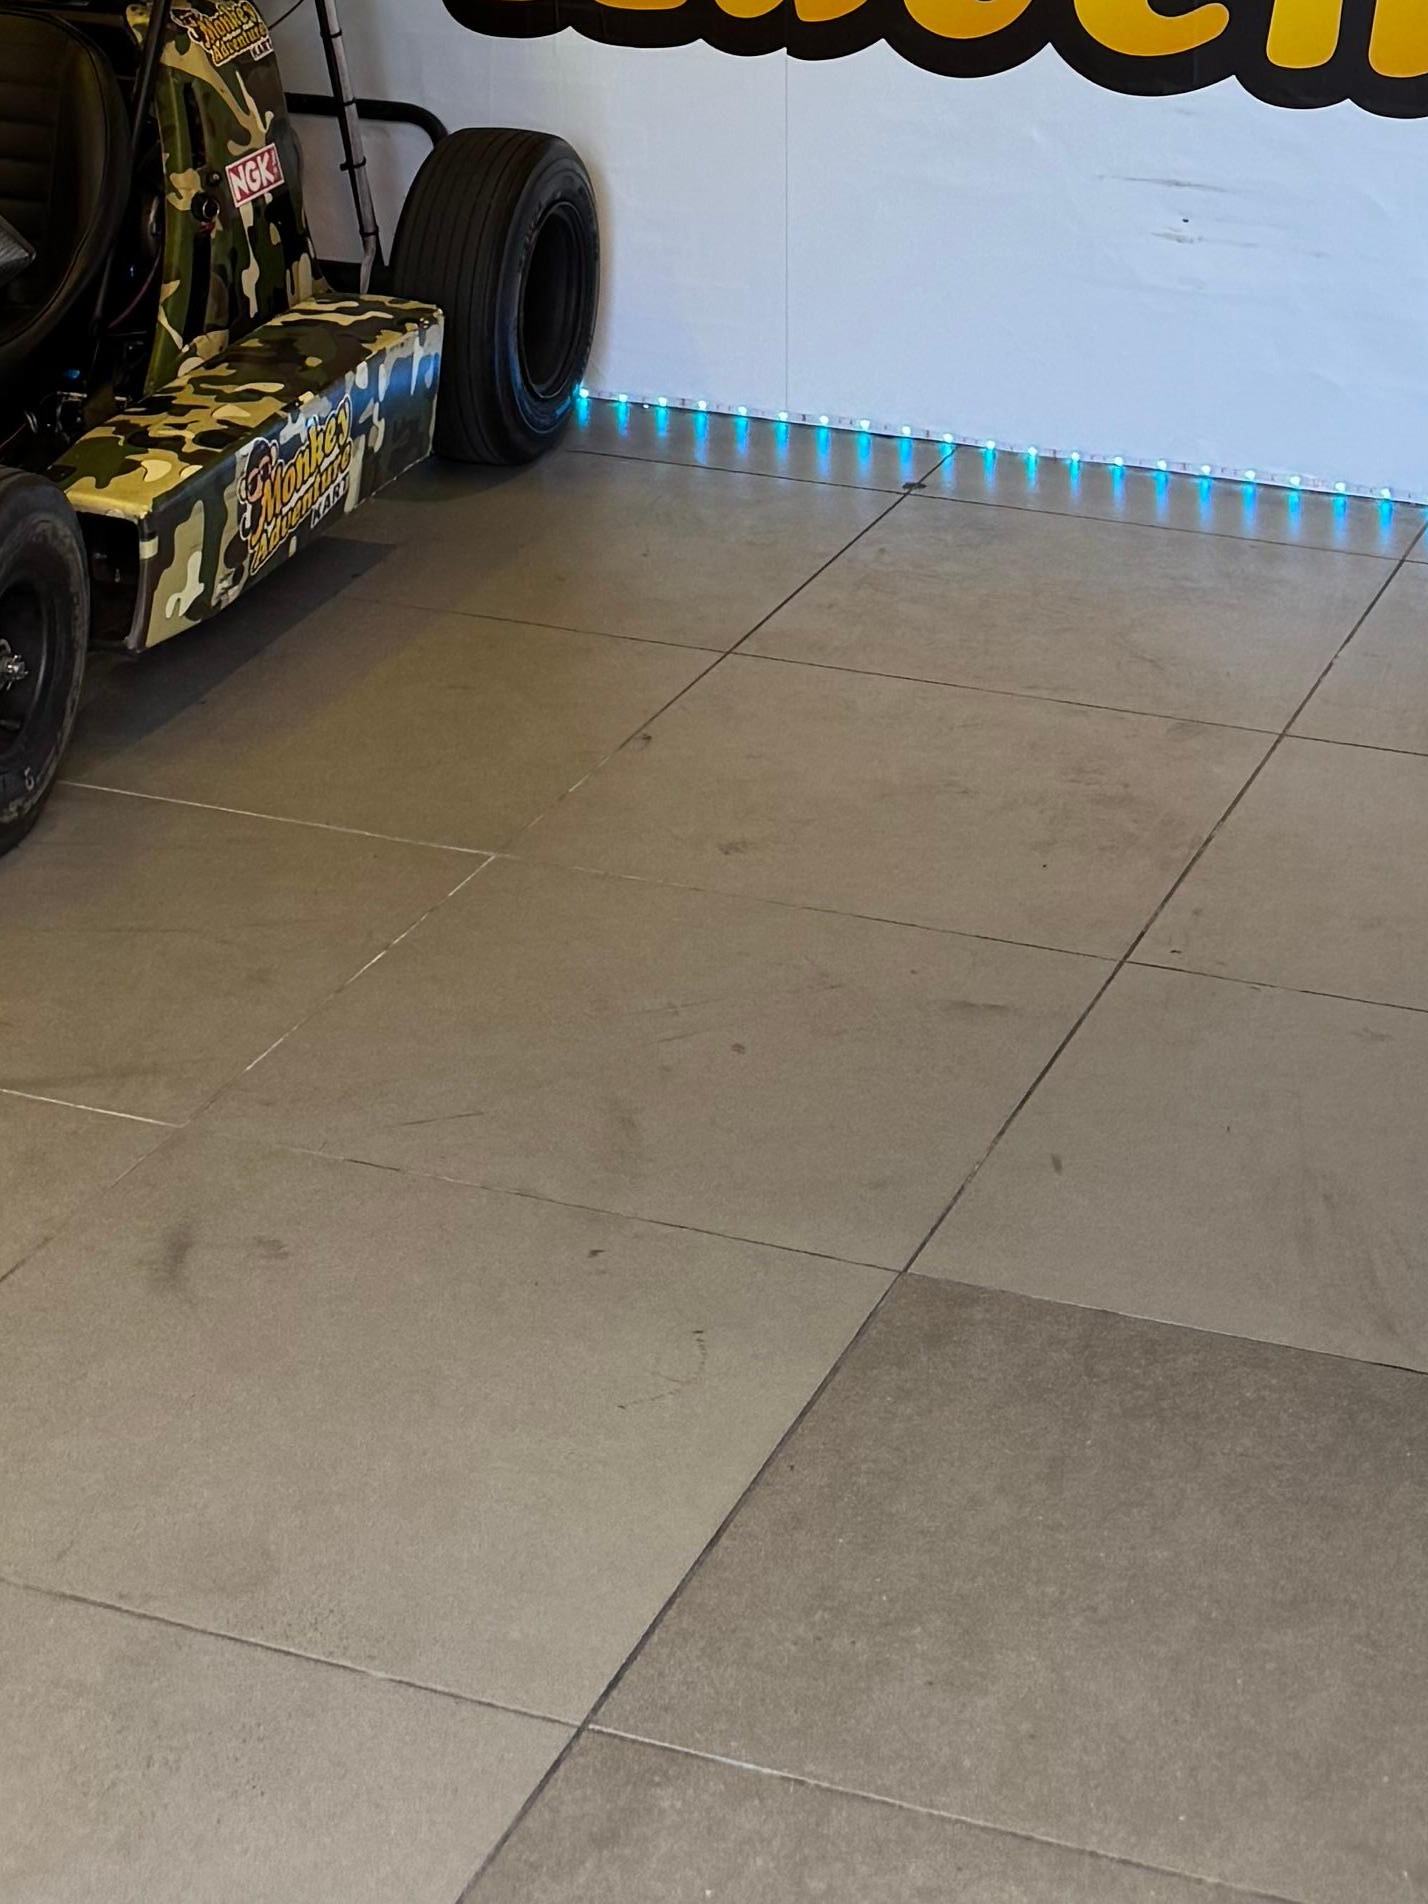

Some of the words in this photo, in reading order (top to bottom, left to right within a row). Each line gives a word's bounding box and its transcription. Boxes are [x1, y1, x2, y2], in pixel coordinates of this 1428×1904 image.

[199, 0, 260, 49] Monkey
[229, 151, 275, 200] NGK
[248, 399, 352, 548] Monkey
[251, 441, 352, 572] Adventure
[311, 477, 349, 526] KART
